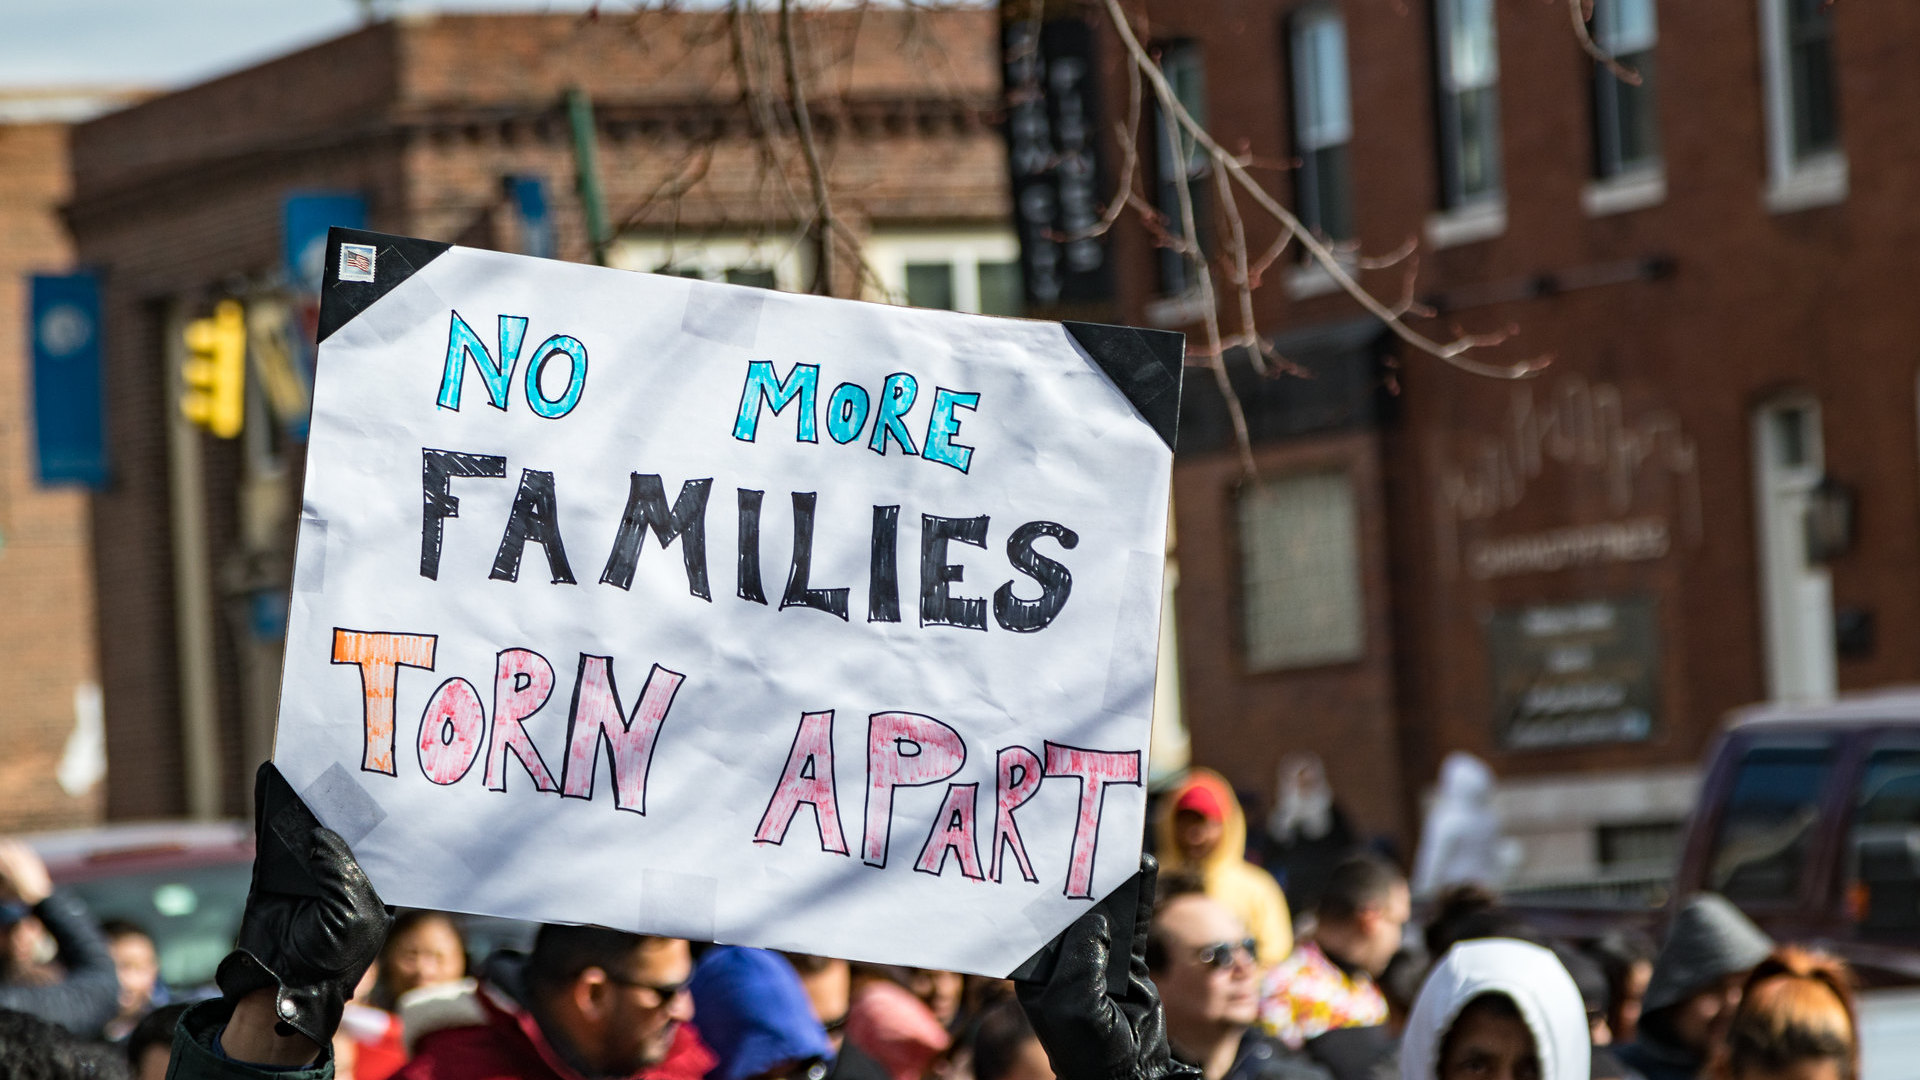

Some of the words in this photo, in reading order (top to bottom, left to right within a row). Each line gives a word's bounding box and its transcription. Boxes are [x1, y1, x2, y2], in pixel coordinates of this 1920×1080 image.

[436, 309, 588, 420] NO
[732, 360, 980, 475] MORE
[419, 446, 1079, 634] FAMILIES
[331, 626, 687, 817] TORN
[752, 709, 1142, 900] APART
